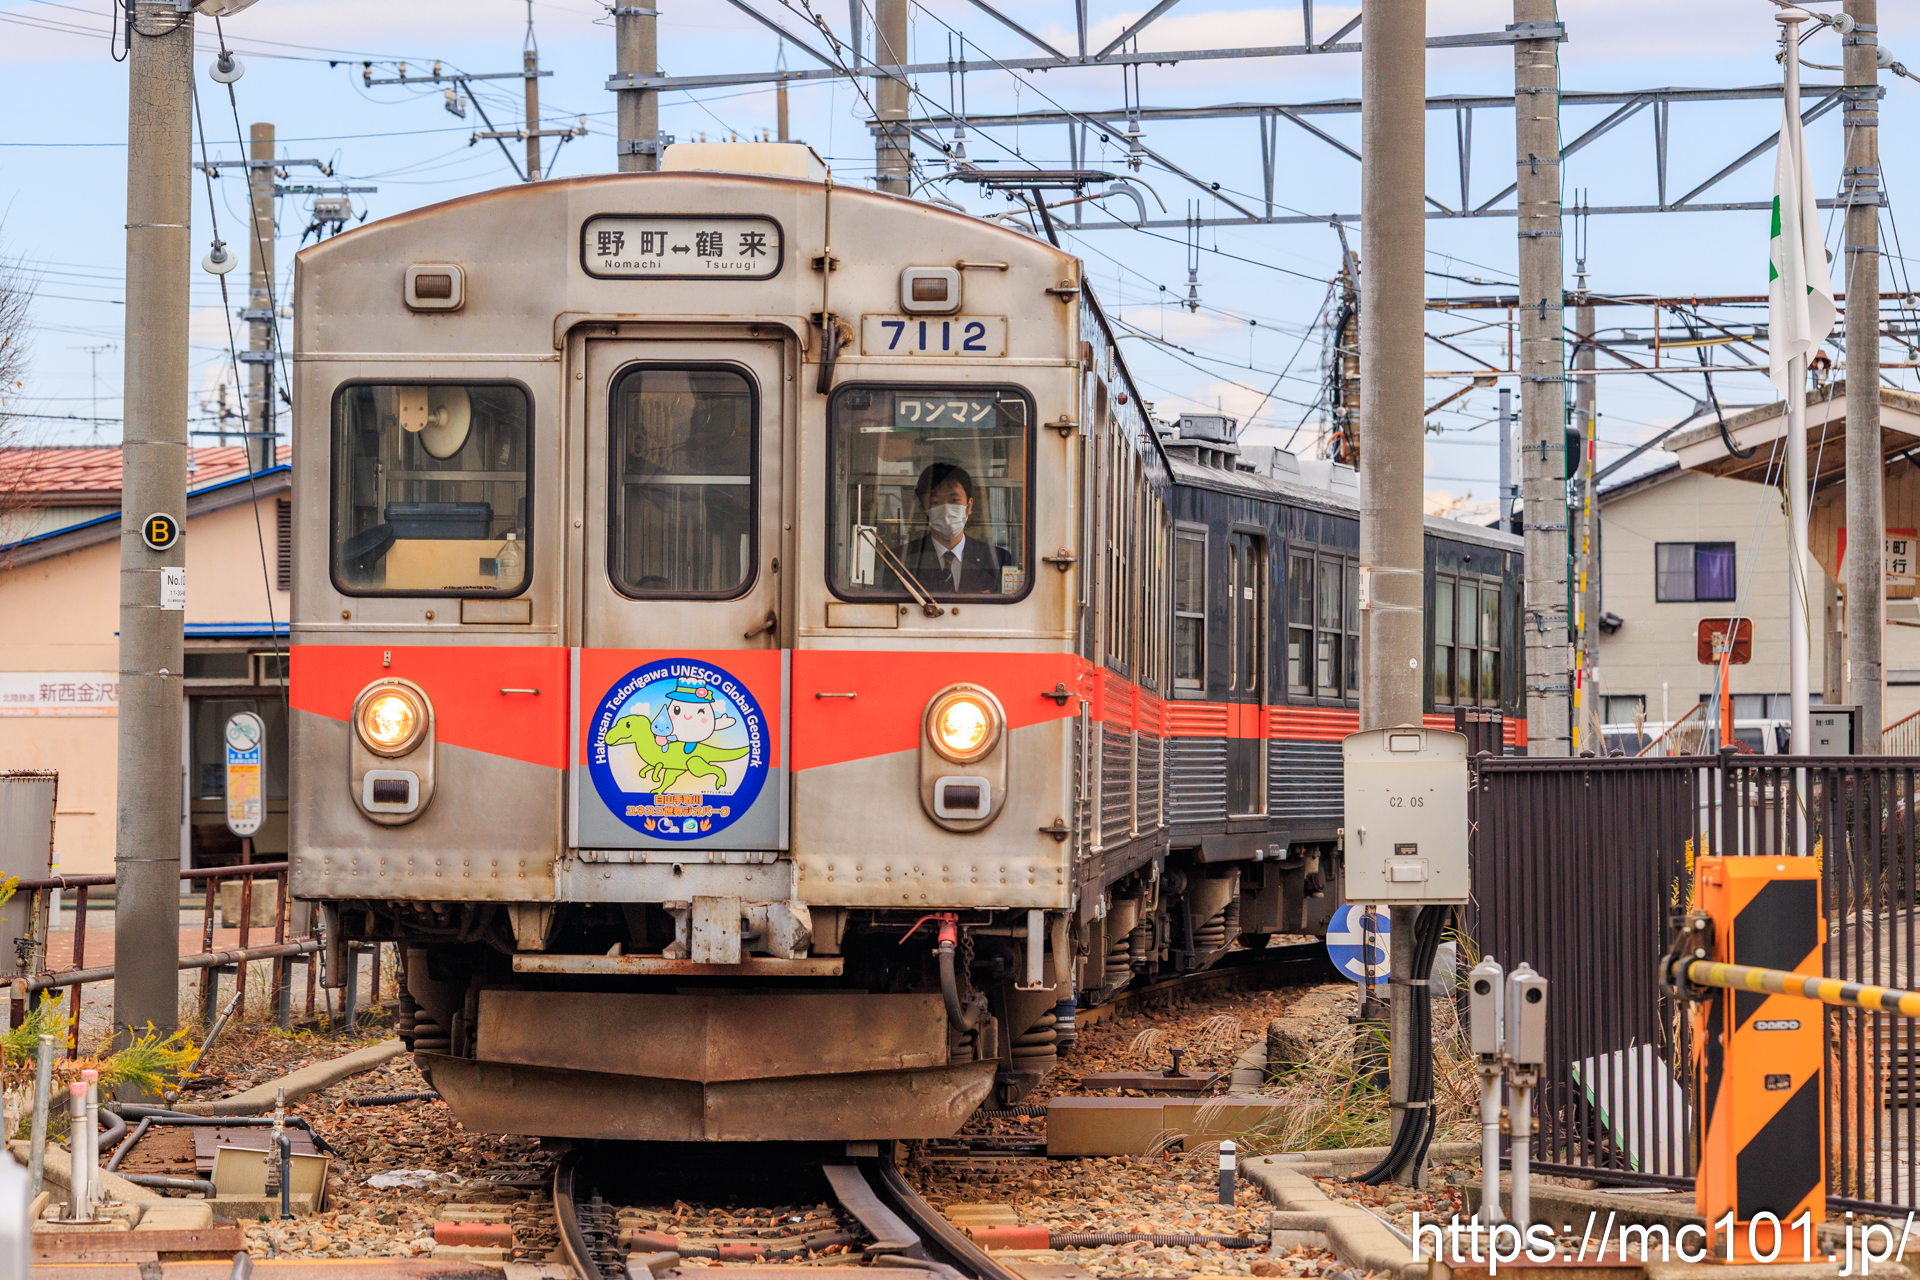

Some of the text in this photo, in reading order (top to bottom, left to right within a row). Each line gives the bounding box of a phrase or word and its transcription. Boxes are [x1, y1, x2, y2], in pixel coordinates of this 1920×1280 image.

[597, 231, 767, 258] 野町 鶴来
[604, 260, 756, 271] Nomachi Tsurugi
[881, 321, 987, 351] 7112
[900, 401, 992, 423] ワンマン
[152, 520, 169, 542] B
[594, 665, 763, 769] Hakusan Tedorigawa UNESCO Global Geopark
[654, 795, 703, 805] 白山手取川
[626, 806, 730, 817] ユネスコ世界ジオパーク
[1756, 1020, 1799, 1030] DAIDO
